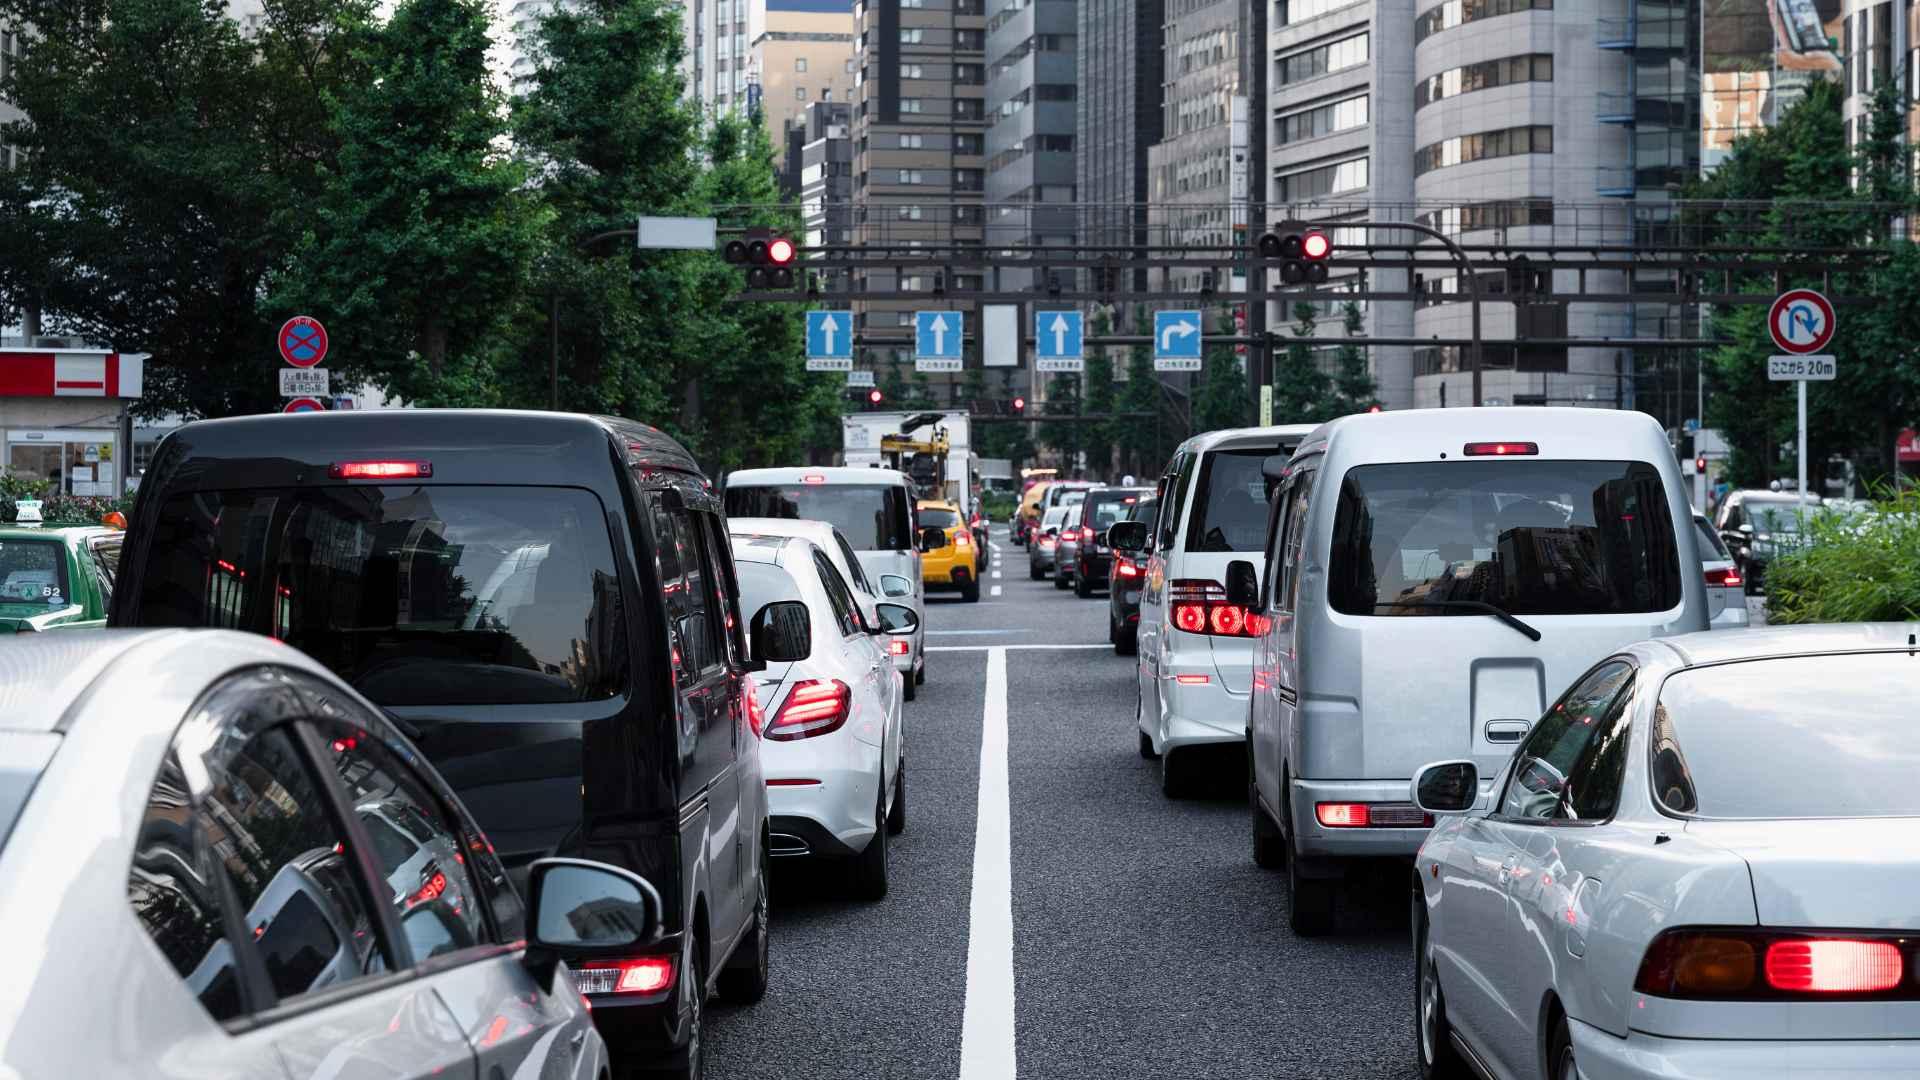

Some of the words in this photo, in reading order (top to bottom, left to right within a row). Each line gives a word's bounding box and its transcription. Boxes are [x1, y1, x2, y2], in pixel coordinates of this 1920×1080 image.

[1772, 361, 1805, 375] ここから
[1807, 361, 1833, 375] 20m
[42, 587, 60, 597] 82
